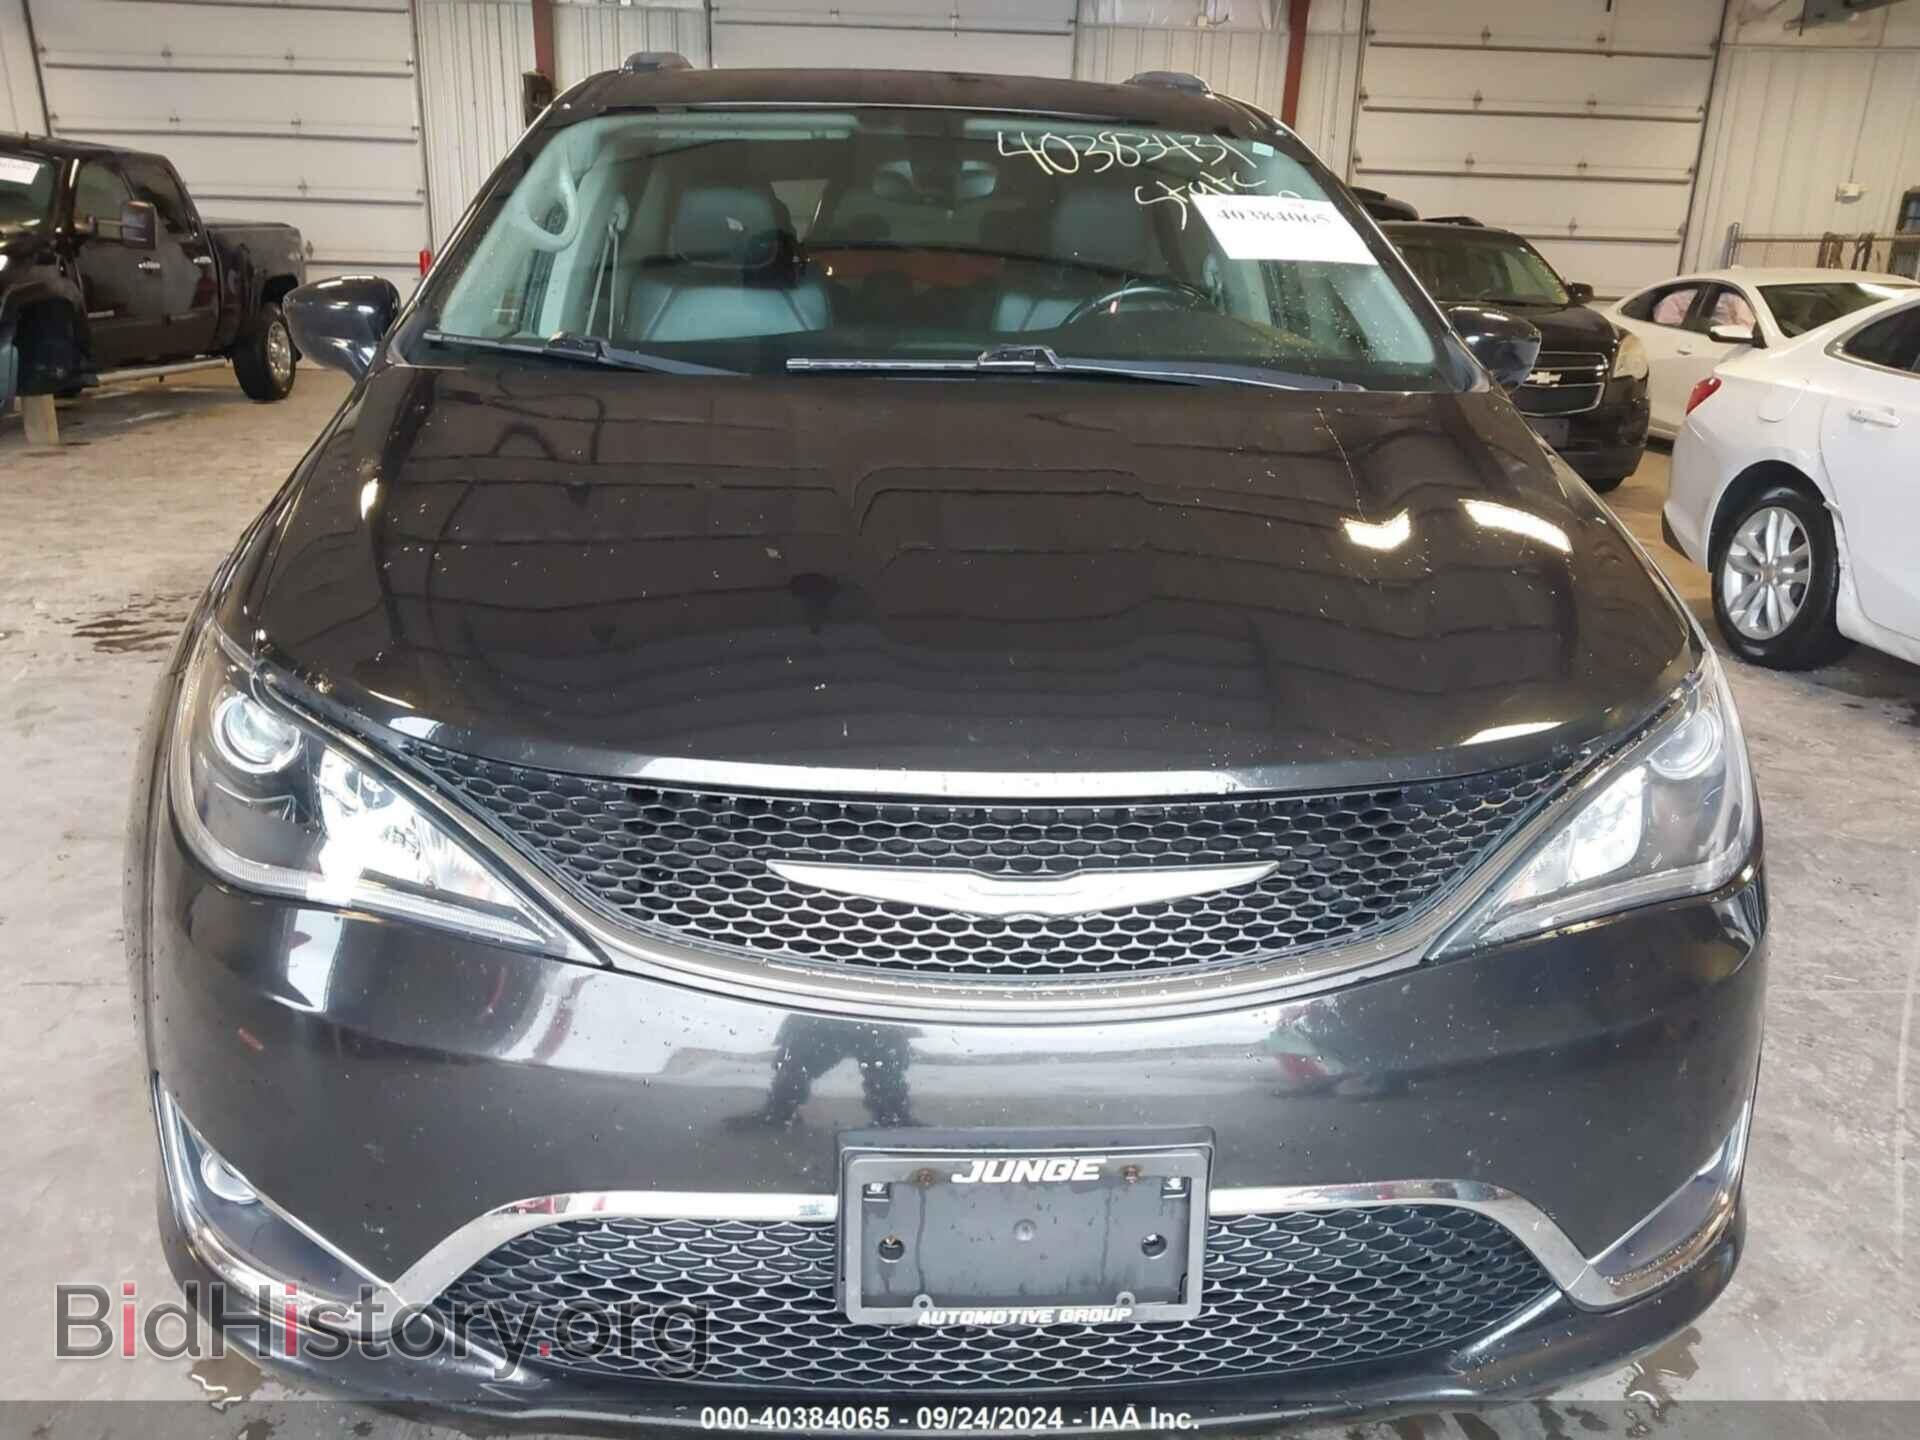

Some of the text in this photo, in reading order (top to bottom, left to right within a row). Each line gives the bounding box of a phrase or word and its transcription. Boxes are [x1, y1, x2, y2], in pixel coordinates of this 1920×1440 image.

[951, 1157, 1107, 1184] JUNGE
[918, 1307, 1132, 1326] AUTOMOTIVE GROUP
